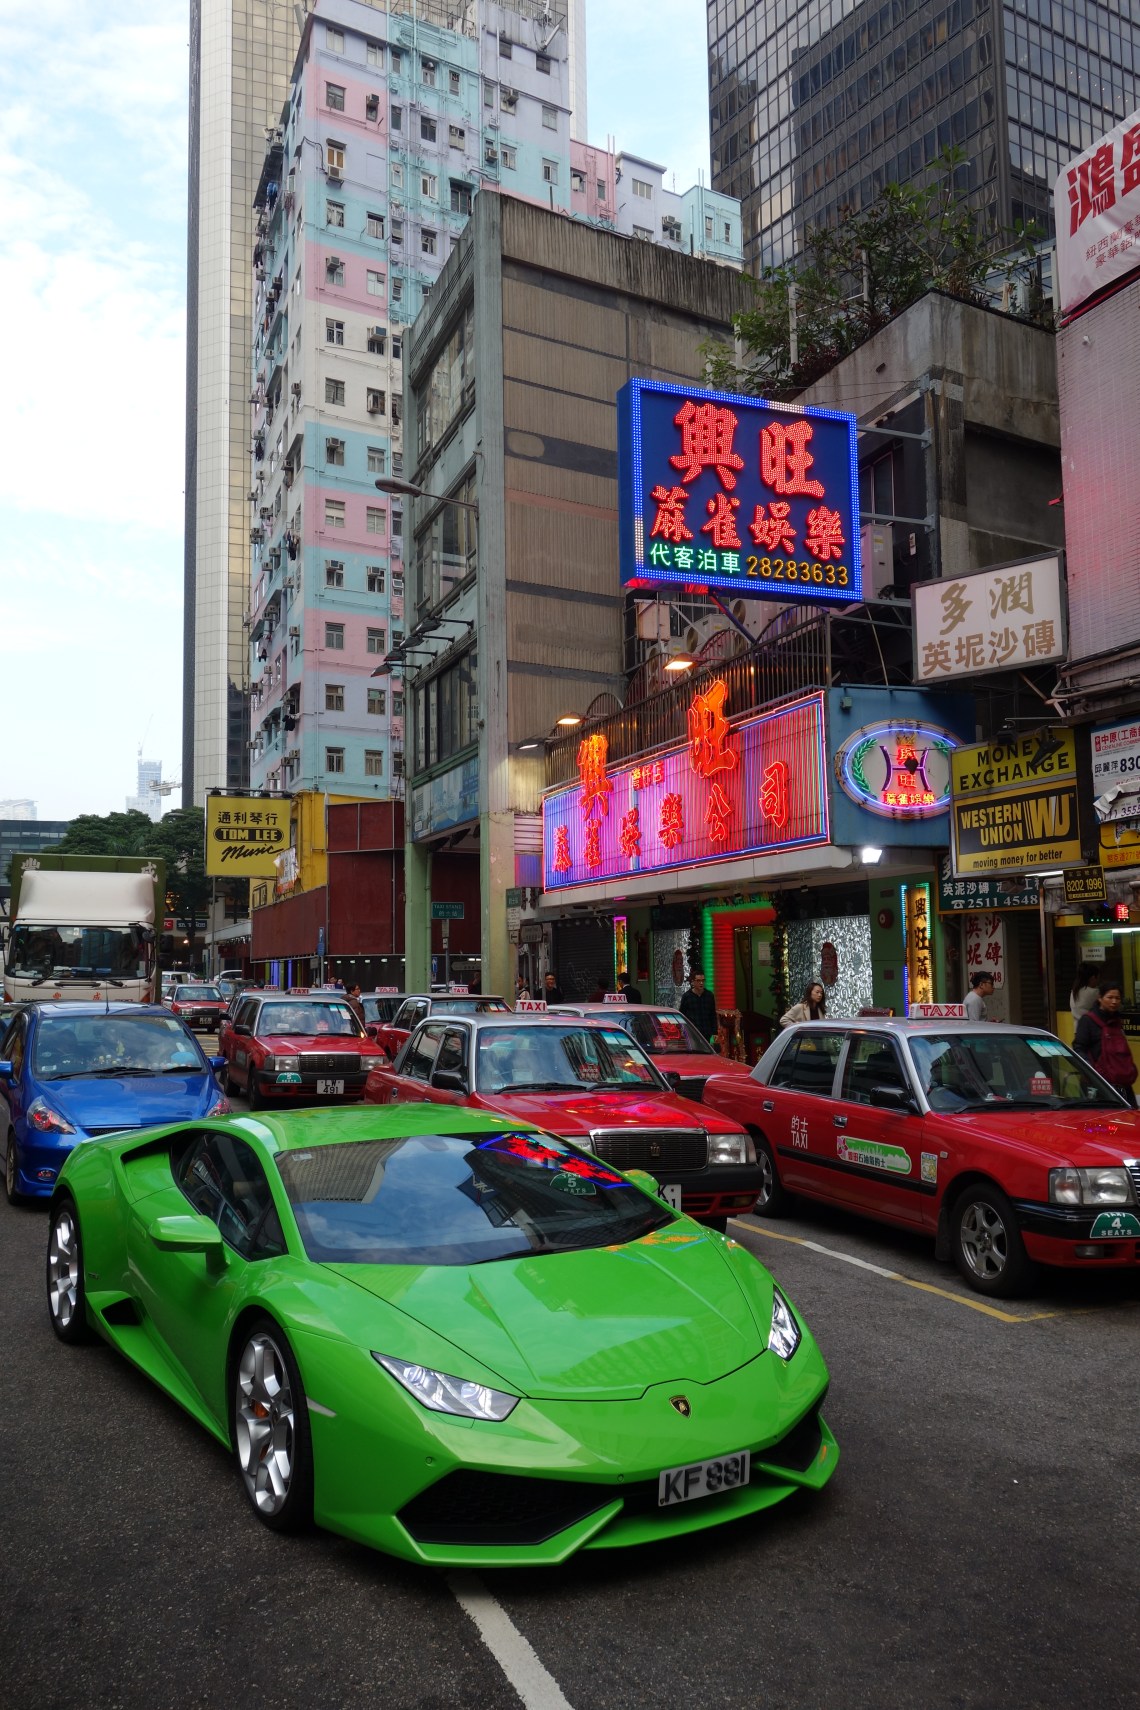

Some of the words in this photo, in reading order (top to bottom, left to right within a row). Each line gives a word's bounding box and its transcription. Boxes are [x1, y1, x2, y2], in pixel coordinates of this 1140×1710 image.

[670, 401, 825, 498] 興旺
[650, 543, 740, 574] 代客泊車
[746, 556, 848, 585] 28283633
[940, 571, 1034, 635] 多潤
[922, 619, 1055, 676] 英坭沙磚
[577, 679, 739, 821] 興旺
[960, 752, 1069, 791] EXCHANGE
[218, 811, 278, 825] 通利琴行
[960, 802, 1021, 829] WESTERN
[221, 828, 250, 840] TOM
[255, 829, 278, 840] LEE
[980, 822, 1023, 846] UNION
[221, 843, 285, 862] Music
[972, 856, 998, 869] moving
[1000, 854, 1024, 866] money
[1026, 851, 1037, 861] for
[1039, 849, 1063, 860] better
[943, 882, 989, 896] 英泥沙磚
[1067, 879, 1085, 892] 8202
[1086, 877, 1103, 890] 1996
[968, 897, 999, 909] 2511
[1003, 894, 1038, 906] 4548
[520, 1000, 546, 1011] TAXI
[608, 994, 626, 1003] TAXI
[920, 1005, 963, 1016] TAXI
[323, 1086, 338, 1094] 491
[791, 1115, 808, 1133] 的士
[791, 1131, 808, 1149] TAXI
[567, 1178, 577, 1188] 5
[1111, 1217, 1122, 1229] 4
